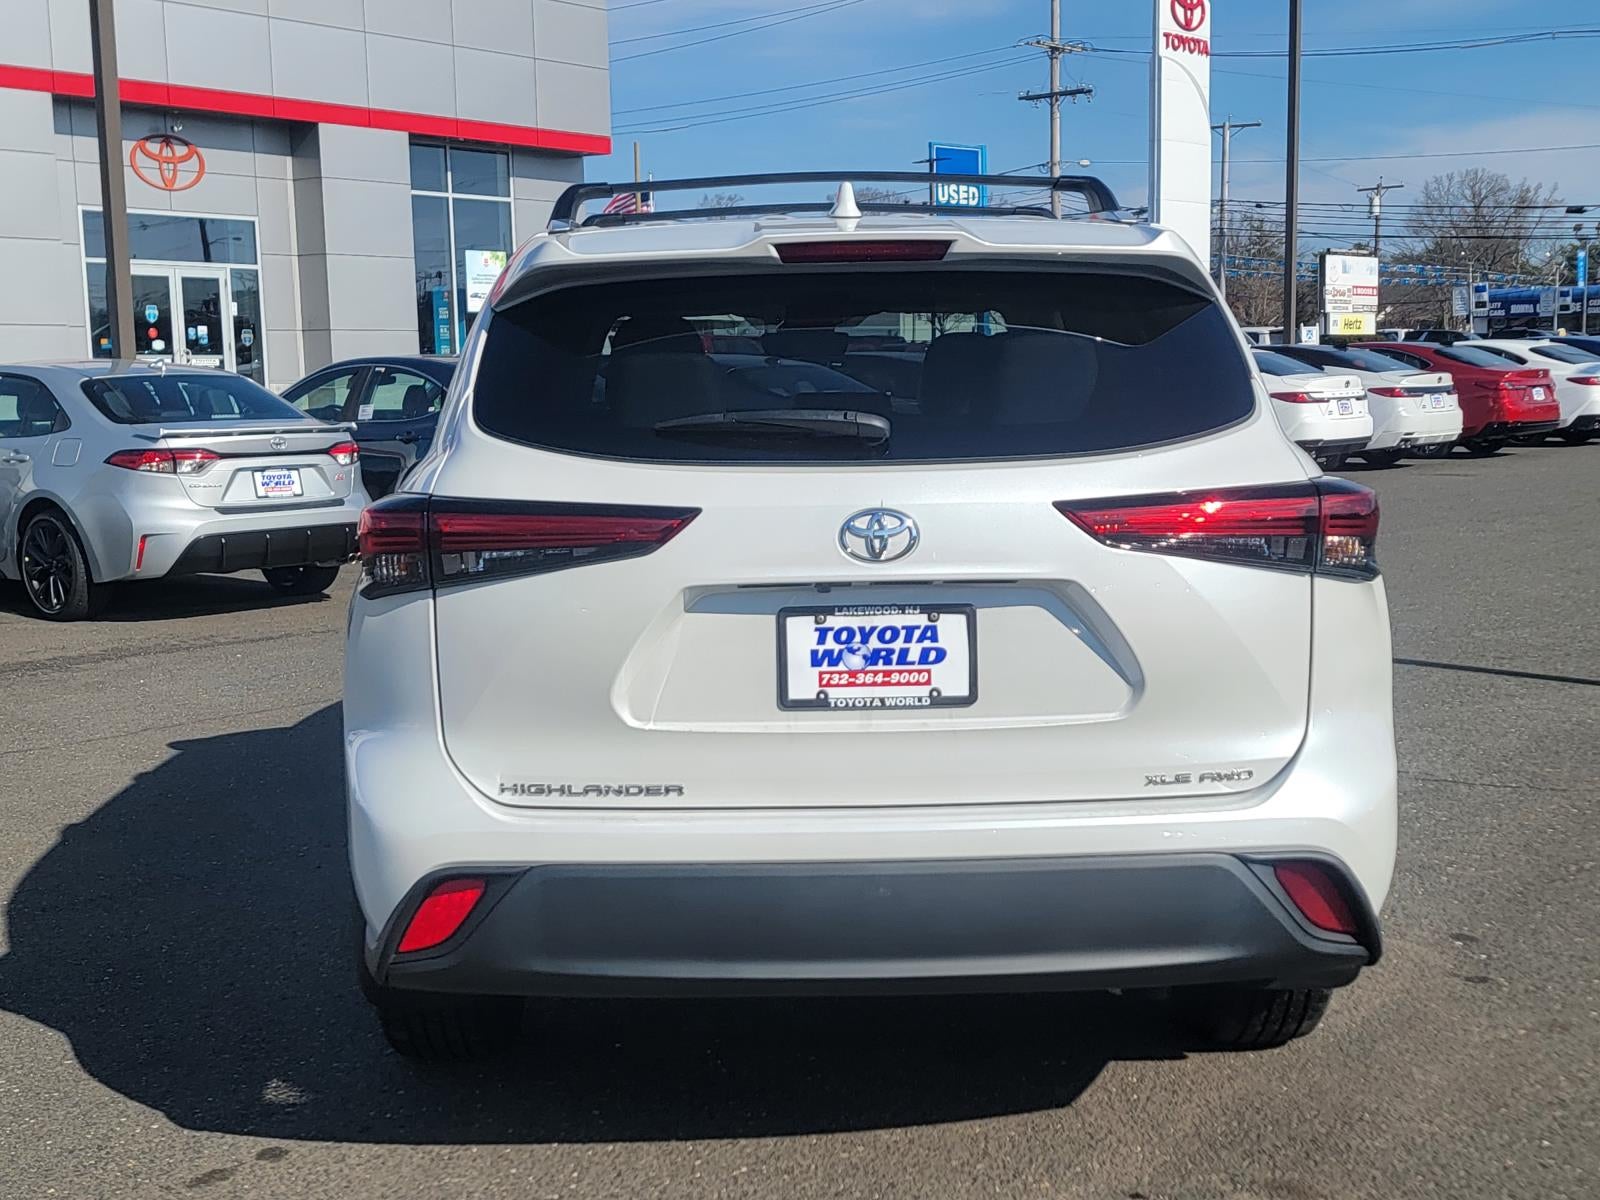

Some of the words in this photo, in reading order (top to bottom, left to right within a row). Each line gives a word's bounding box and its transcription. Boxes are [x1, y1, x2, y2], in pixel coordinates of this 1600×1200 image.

[1163, 32, 1209, 57] TOYOTA
[938, 183, 979, 206] USED
[1343, 318, 1362, 330] Hertz
[261, 473, 292, 481] TOYOTA
[905, 606, 921, 615] NJ
[814, 624, 939, 646] TOYOTA
[810, 646, 948, 670] WORLD
[820, 671, 929, 686] 732-364-9000
[829, 697, 882, 708] TOYOTA
[884, 696, 931, 706] WORLD
[1144, 773, 1192, 787] XLE
[1198, 769, 1254, 783] AWD
[499, 783, 685, 797] HIGHLANDER
